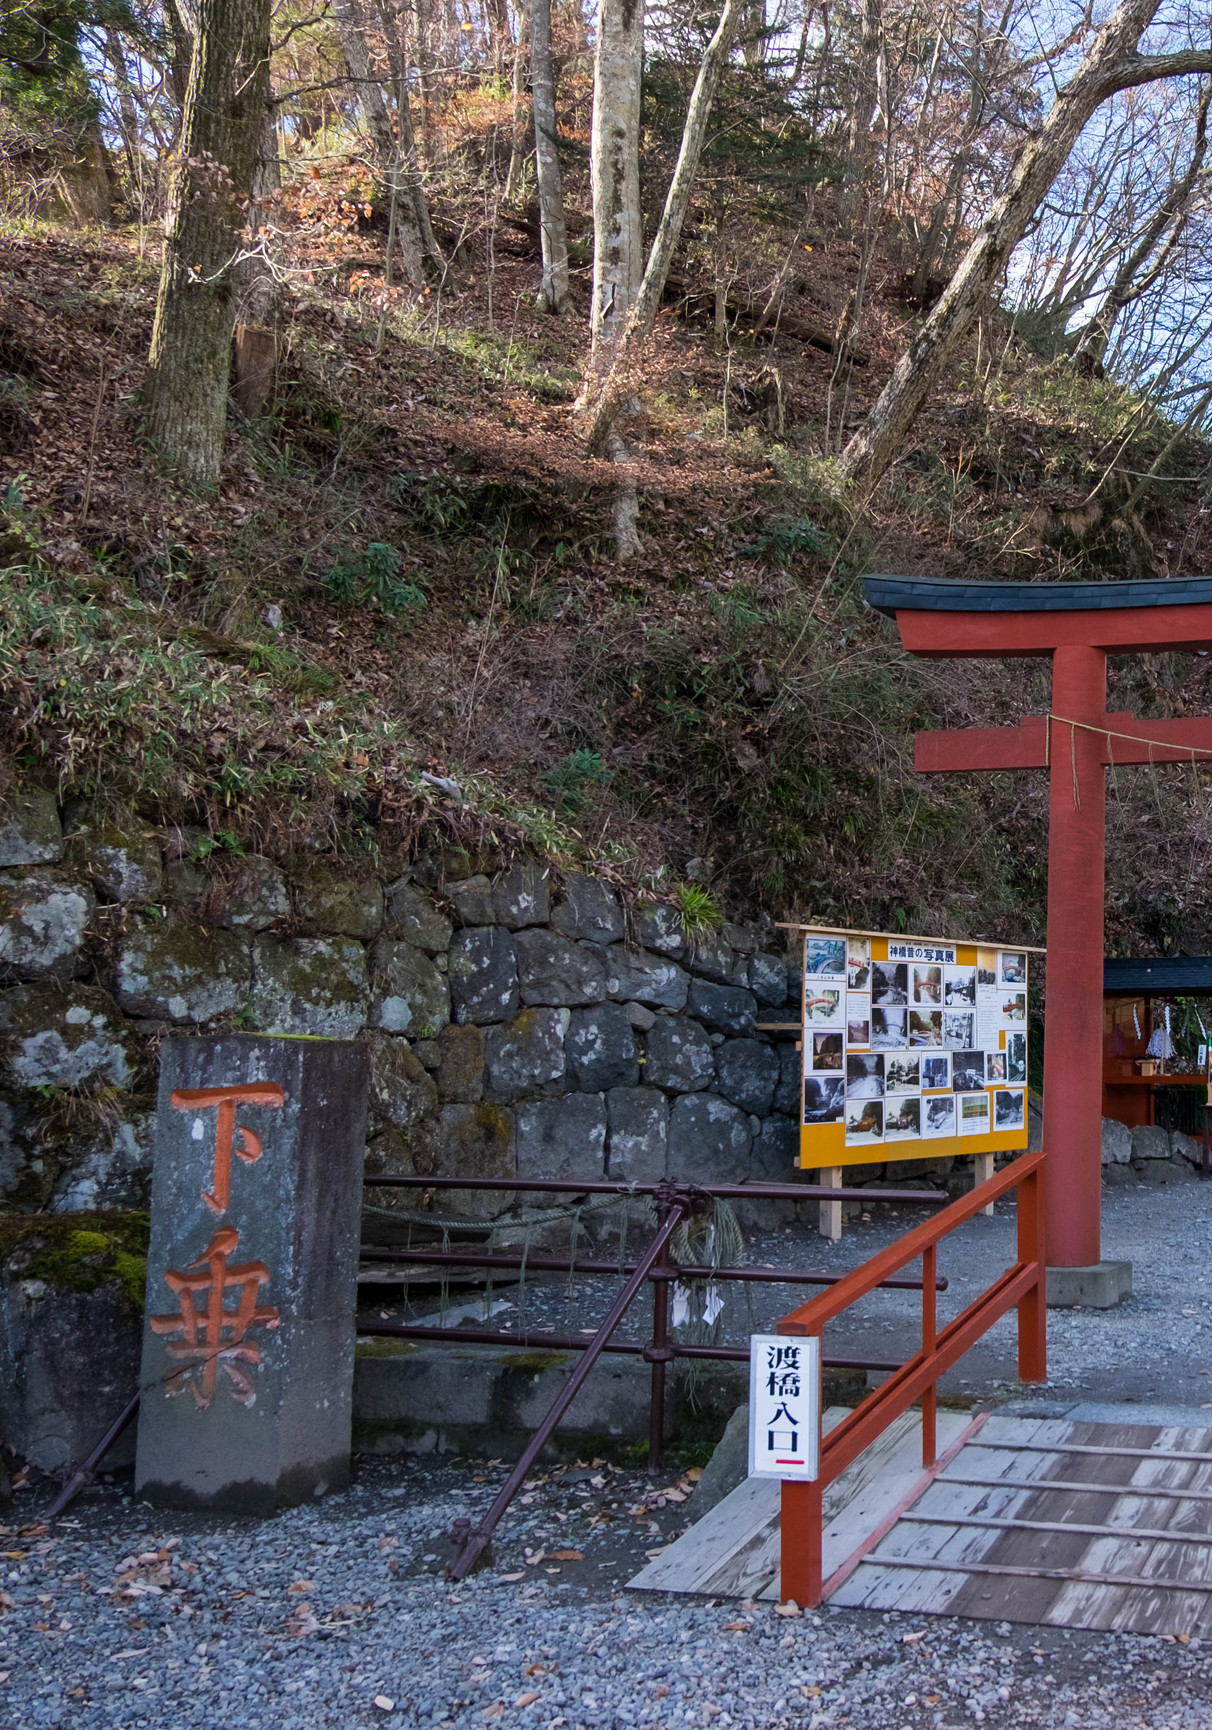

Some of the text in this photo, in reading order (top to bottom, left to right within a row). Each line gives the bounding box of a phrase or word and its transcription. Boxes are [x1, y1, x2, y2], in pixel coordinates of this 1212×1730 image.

[150, 1082, 285, 1411] 下乗
[765, 1345, 801, 1453] 渡橋入口
